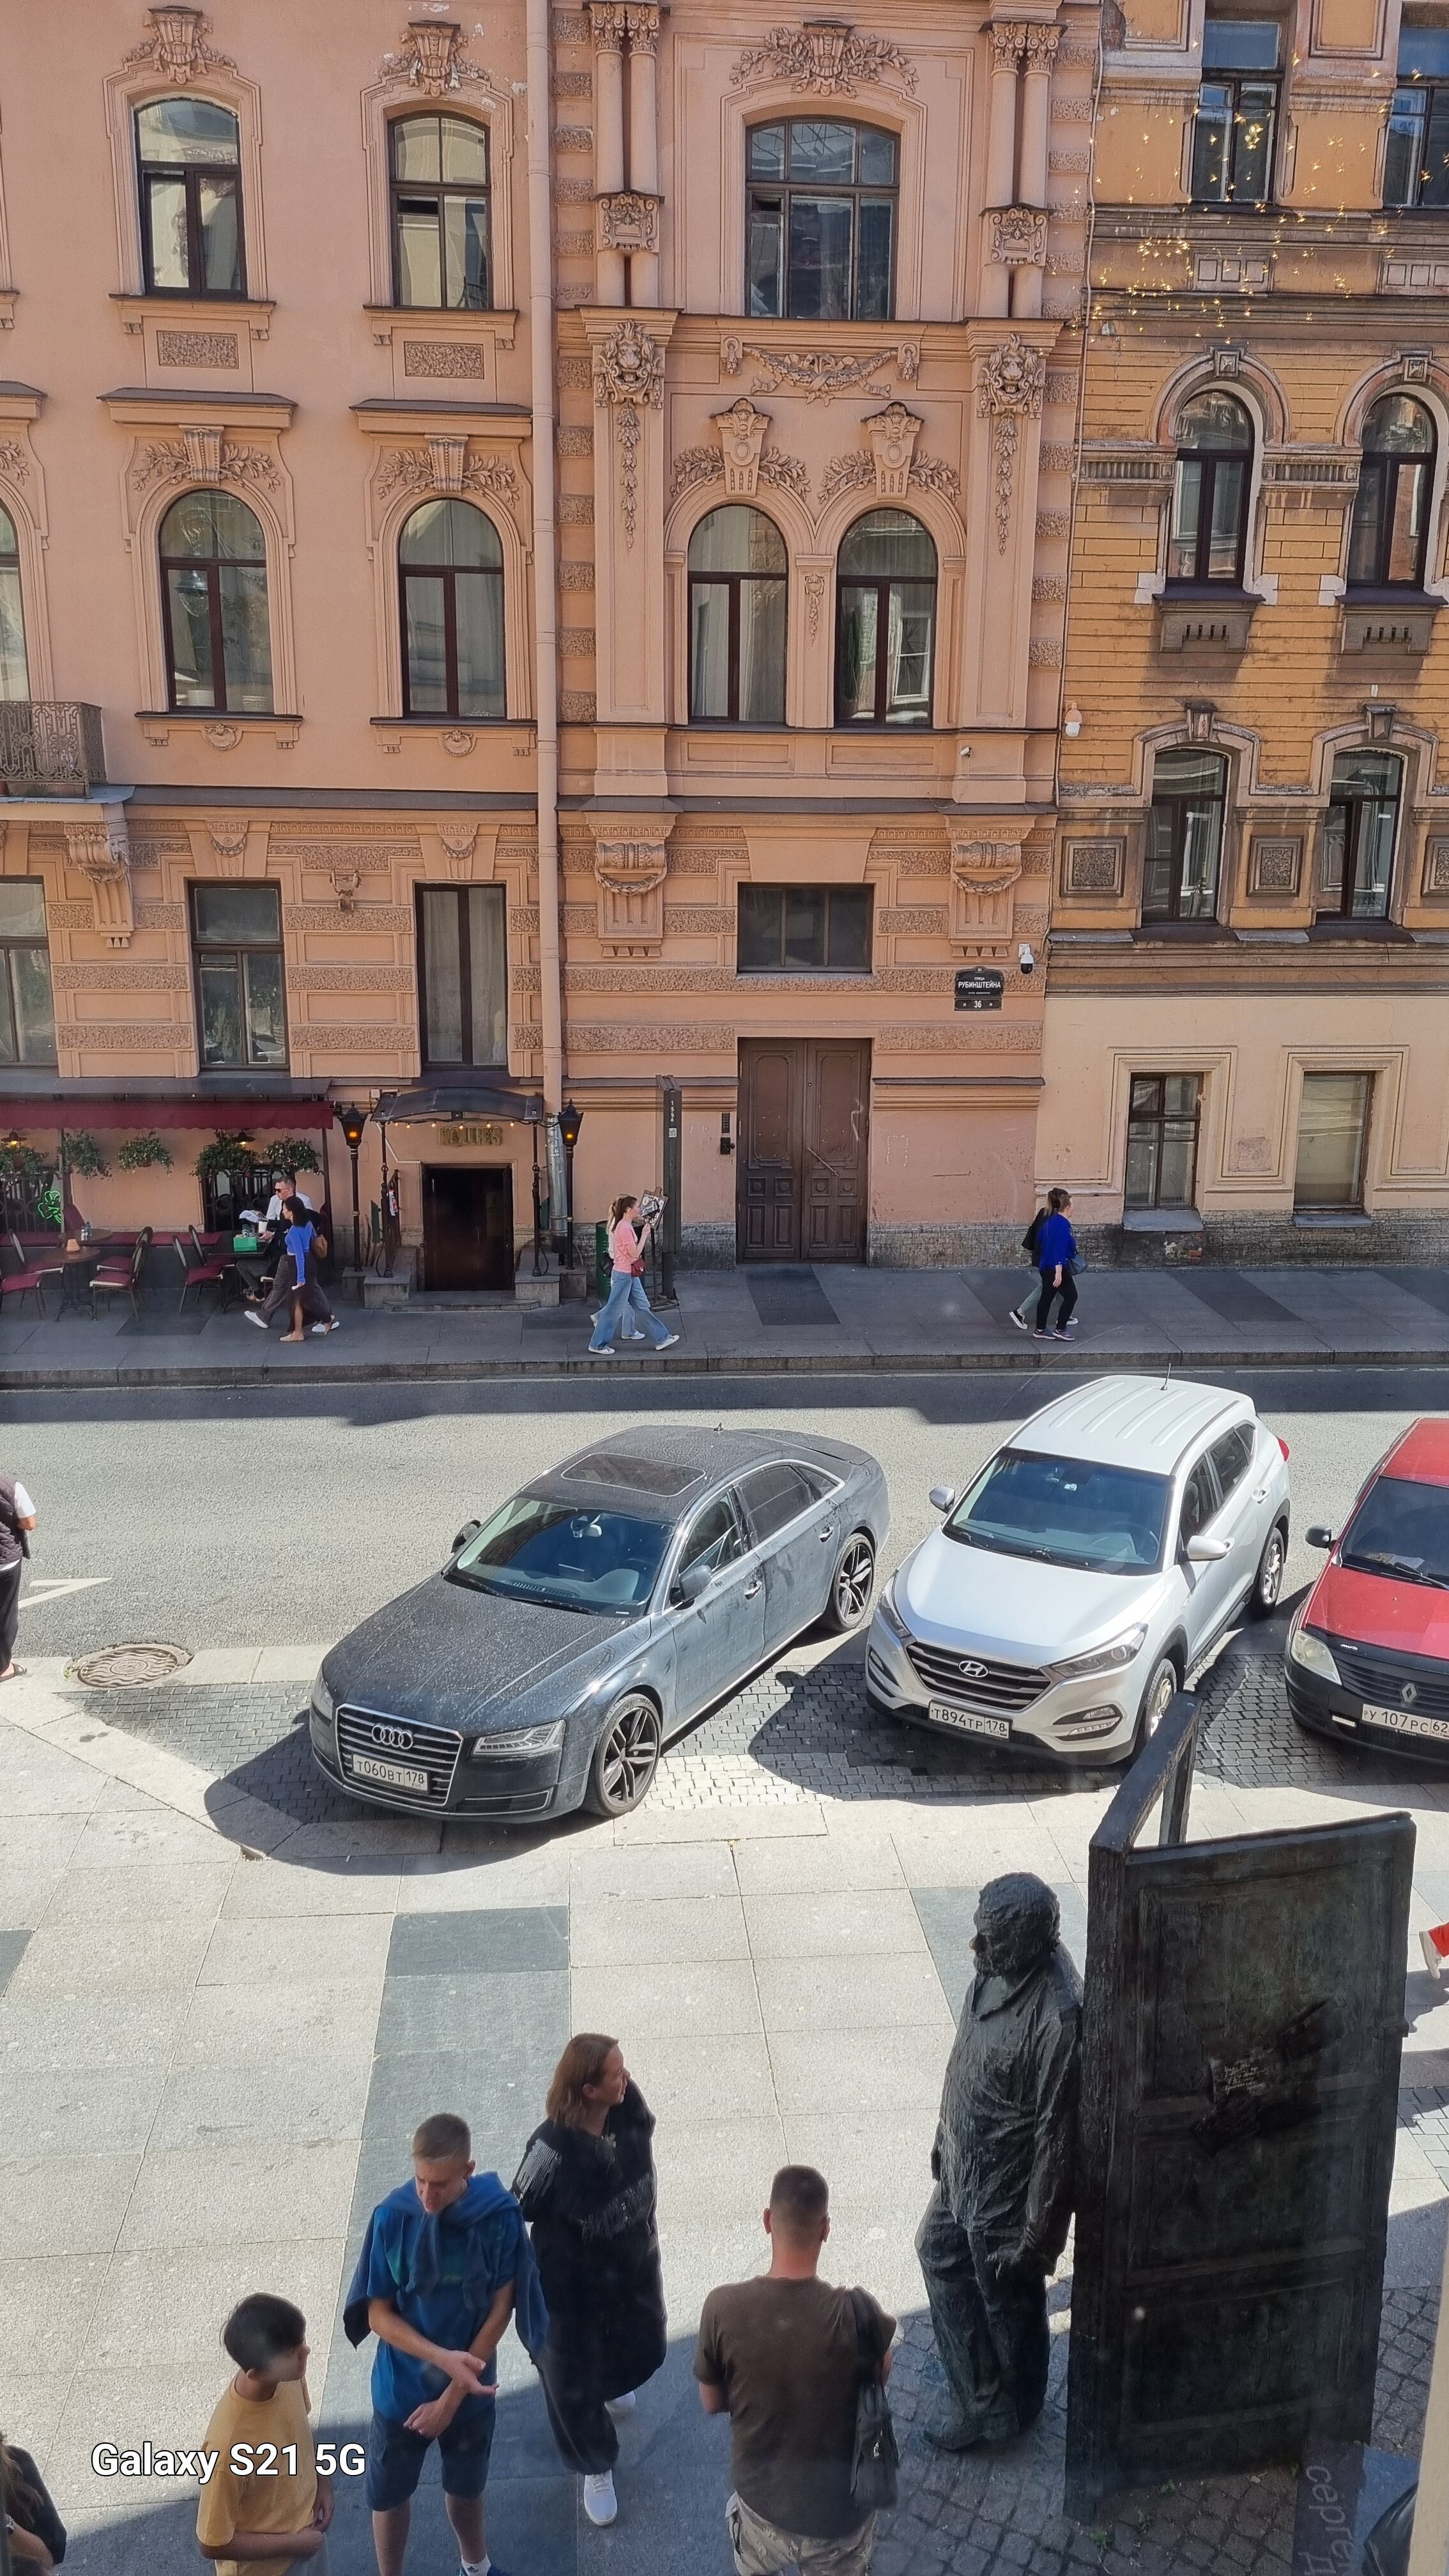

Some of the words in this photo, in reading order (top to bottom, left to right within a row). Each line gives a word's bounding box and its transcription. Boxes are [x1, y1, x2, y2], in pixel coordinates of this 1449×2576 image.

[958, 980, 1001, 988] РУБИНШТЕЙНА
[974, 1000, 982, 1008] 36
[986, 1720, 1006, 1732] 178
[1432, 1721, 1448, 1733] 62
[406, 1770, 424, 1784] 178
